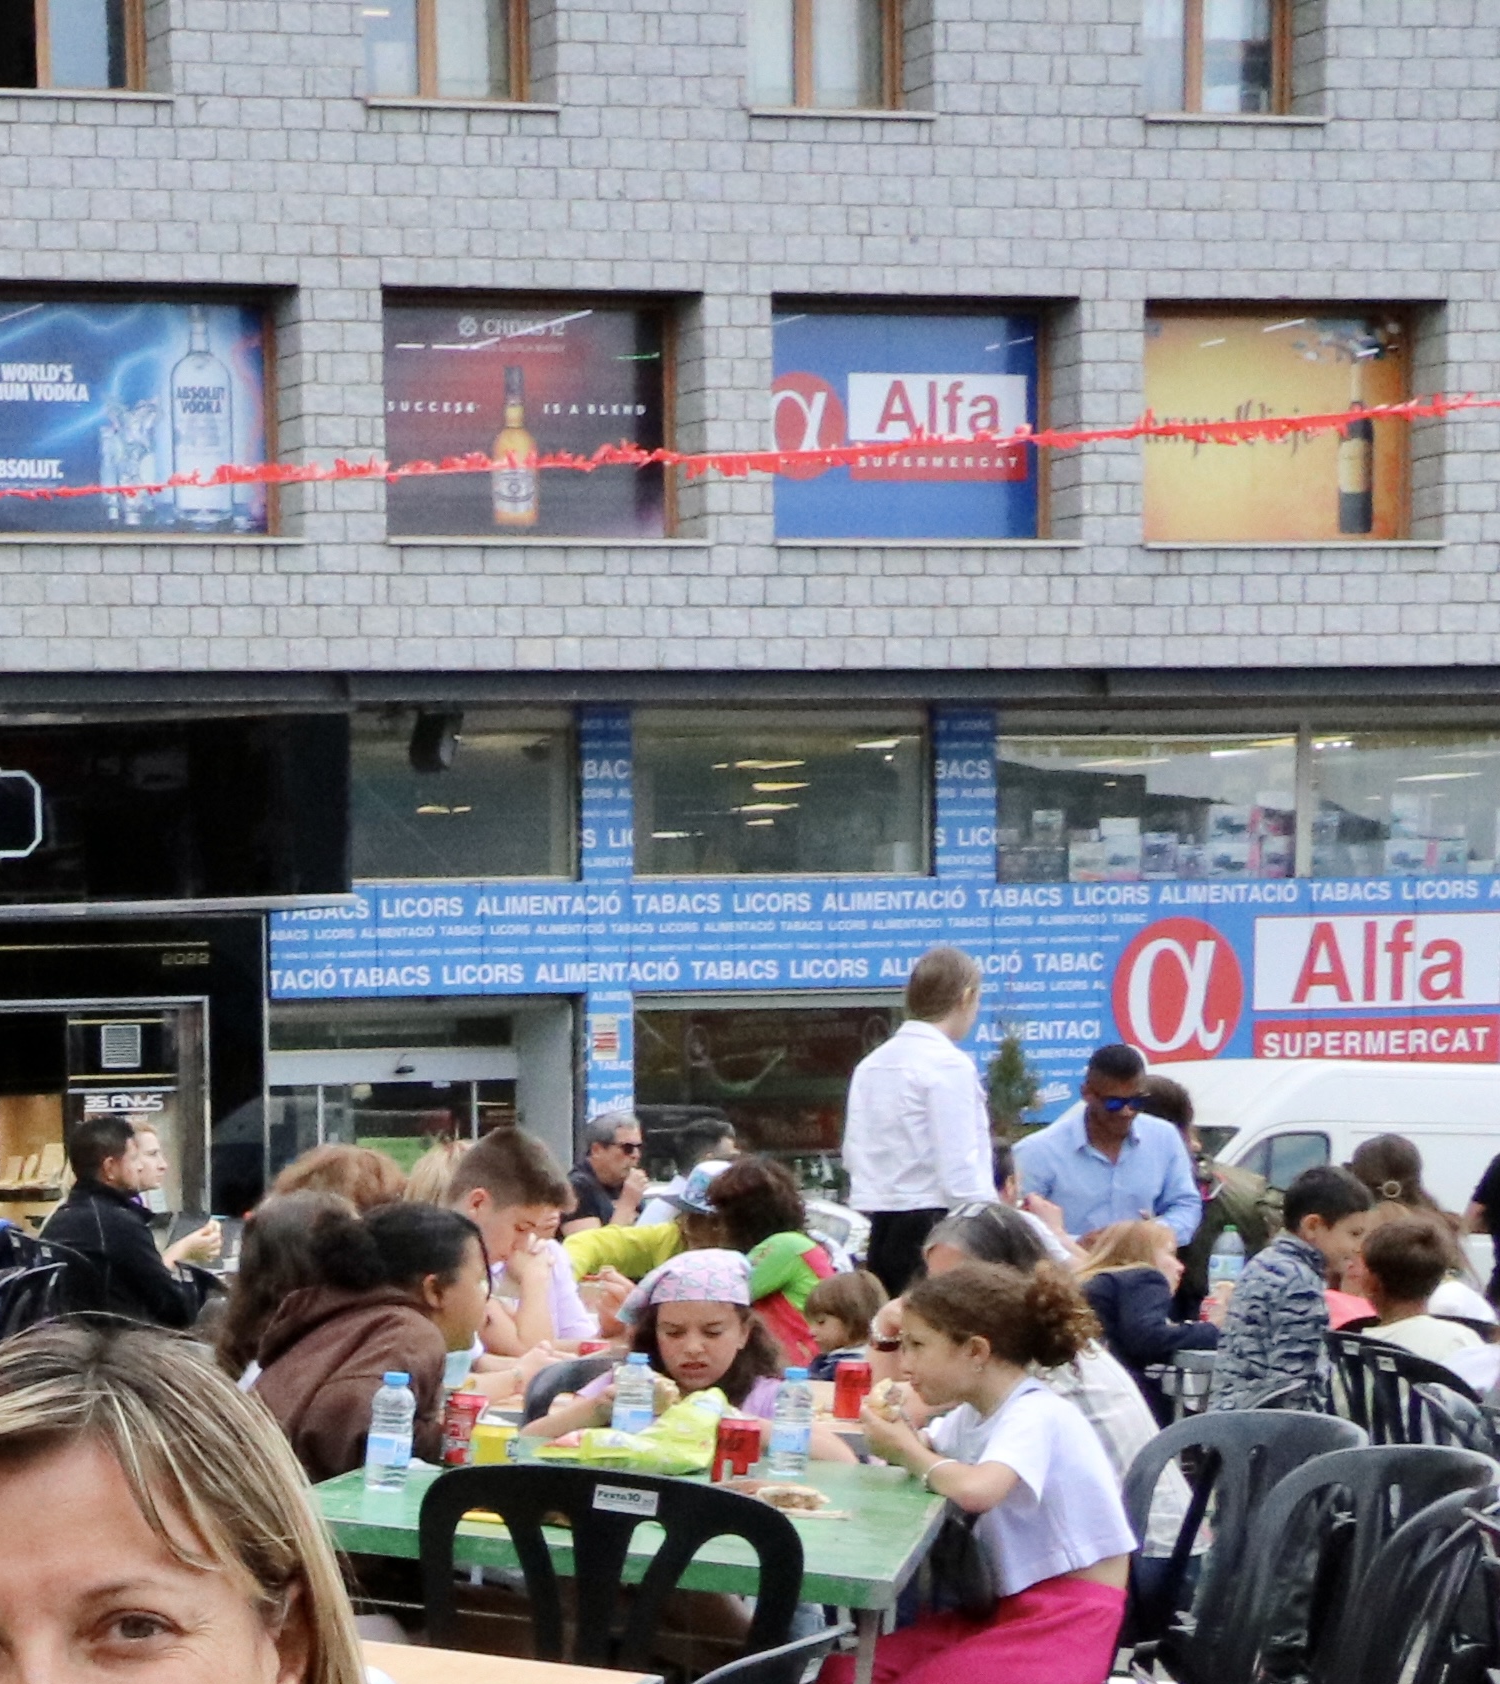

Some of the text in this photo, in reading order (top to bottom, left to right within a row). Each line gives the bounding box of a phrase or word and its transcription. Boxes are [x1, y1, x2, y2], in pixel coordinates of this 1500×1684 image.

[0, 363, 74, 382] WORLD'S
[31, 382, 90, 402] VODKA
[176, 386, 225, 400] ABSOLUT
[181, 400, 222, 415] VODKA
[543, 404, 561, 415] IS
[569, 404, 579, 416] A
[588, 404, 648, 417] BLEND
[876, 379, 1000, 435] Alfa
[858, 456, 1019, 469] SUPERMERCAT
[279, 900, 368, 920] TABACS
[381, 896, 463, 918] LICORS
[474, 890, 622, 917] ALIMENTACIÓ
[632, 893, 722, 914] TABACS
[733, 892, 812, 914] LICORS
[821, 884, 966, 912] ALIMENTACIÓ
[977, 887, 1063, 908] TABACS
[1073, 886, 1150, 906] LICORS
[1158, 878, 1298, 904] ALIMENTACIÓ
[1309, 880, 1392, 901] TABACS
[1402, 879, 1478, 899] LICORS
[439, 926, 485, 937] TABACS
[489, 924, 531, 936] LICORS
[779, 920, 823, 932] TABACS
[161, 951, 211, 966] 2022
[1290, 919, 1465, 1003] Alfa
[270, 951, 1105, 990] TACIÓ TABACS LICORS ALIMENTACIÓ TABACS LICORS ALIACIÓ TABAC
[1261, 1026, 1490, 1057] SUPERMERCAT
[84, 1093, 164, 1112] 35 ANYS
